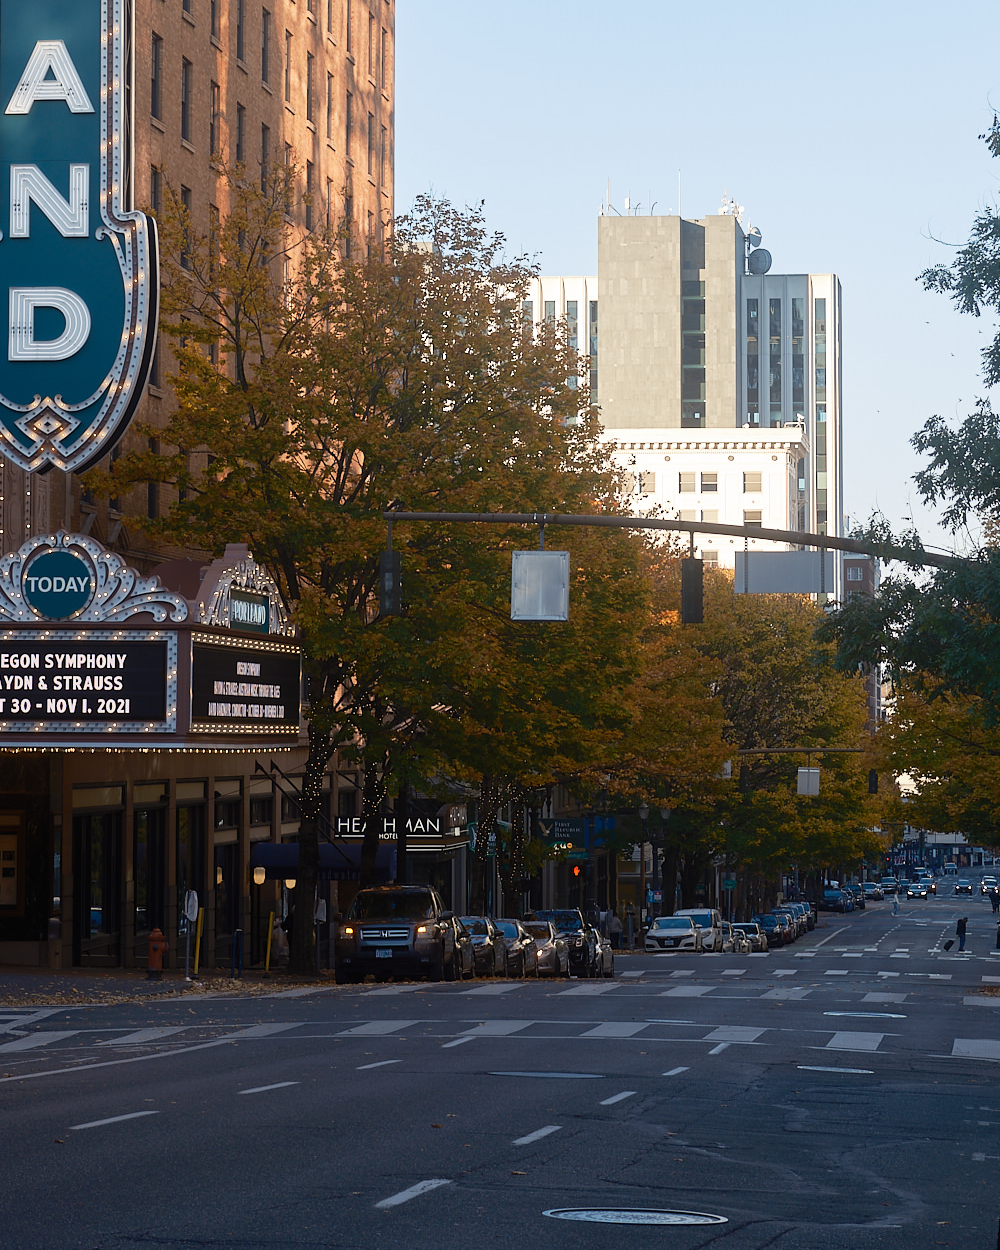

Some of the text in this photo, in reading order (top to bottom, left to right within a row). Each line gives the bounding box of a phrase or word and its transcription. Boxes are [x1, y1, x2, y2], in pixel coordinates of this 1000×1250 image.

[27, 576, 90, 593] TODAY
[44, 653, 127, 669] SYMPHONY
[37, 675, 48, 691] &
[53, 675, 123, 691] STRAUSS
[10, 698, 31, 714] 30
[46, 698, 77, 714] NOV
[97, 698, 130, 714] 2021
[338, 817, 440, 833] HEHAN
